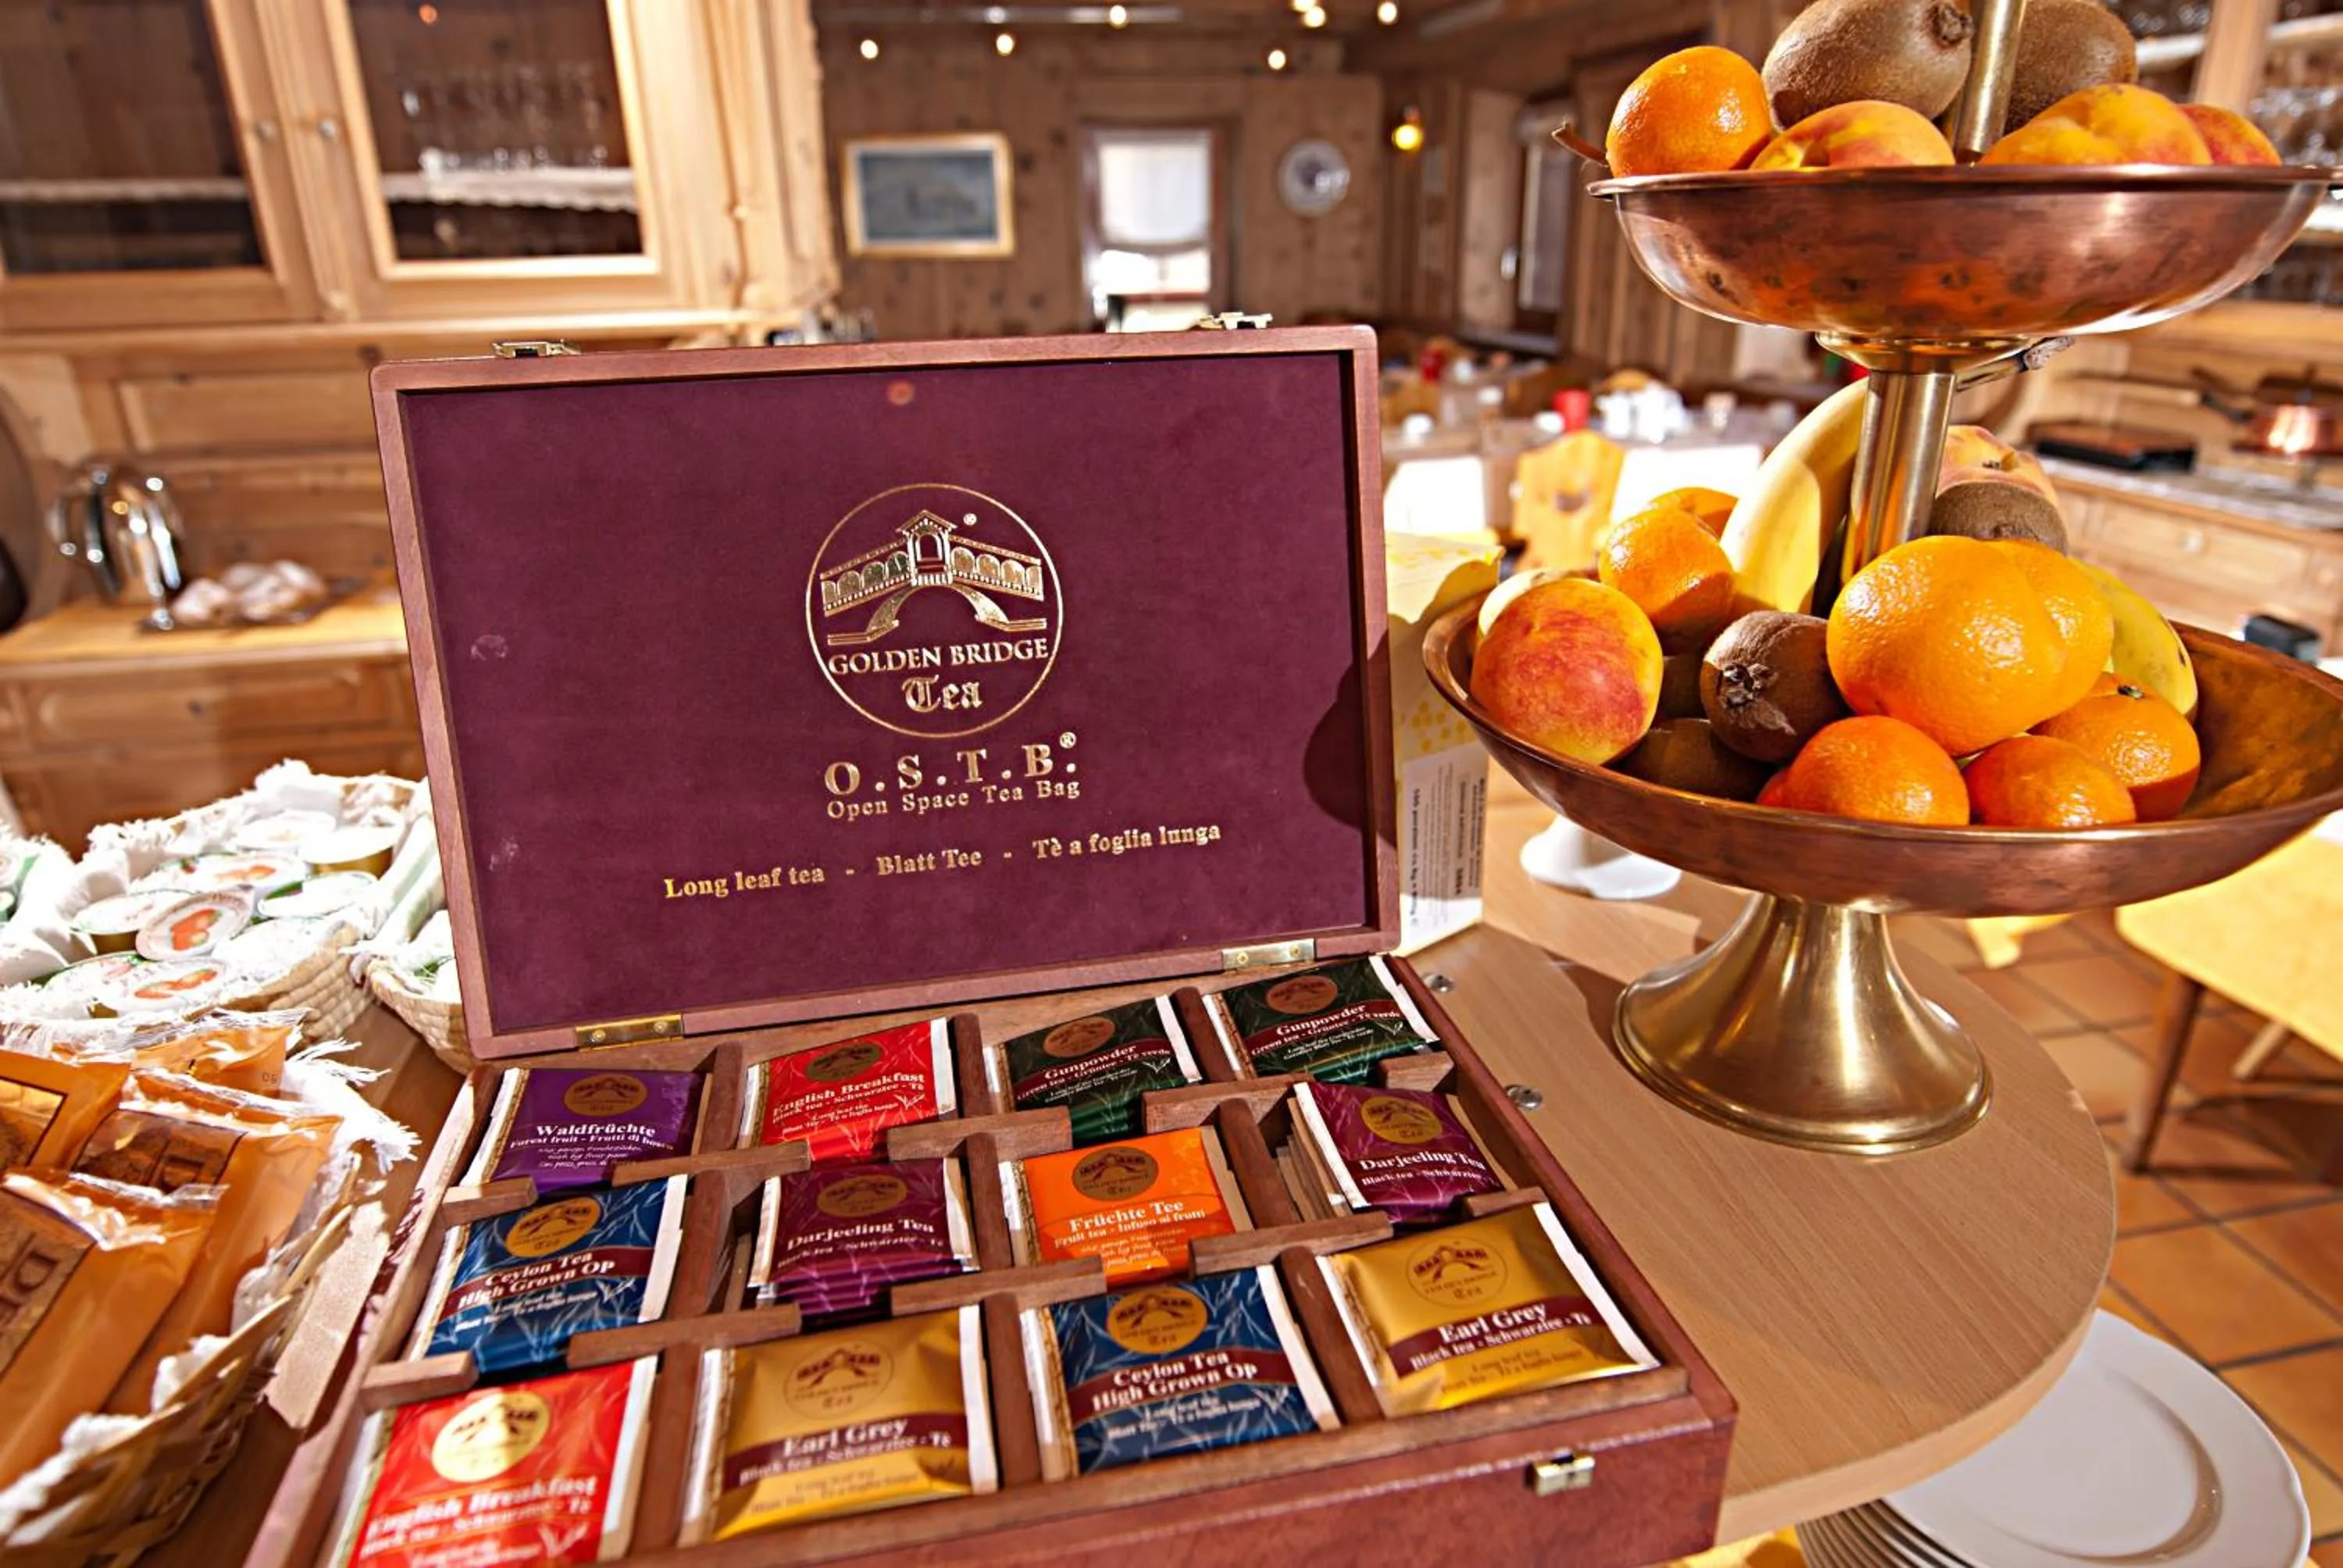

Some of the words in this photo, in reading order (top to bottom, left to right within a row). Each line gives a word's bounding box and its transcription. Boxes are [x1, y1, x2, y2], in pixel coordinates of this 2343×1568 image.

[829, 647, 942, 675] GOLDEN
[949, 637, 1049, 666] BRIDGE
[901, 674, 982, 712] Tea
[827, 800, 888, 821] Open
[902, 792, 969, 814] Space
[982, 784, 1024, 804] Tea
[1036, 780, 1080, 798] Bag
[664, 878, 729, 898] Long
[734, 867, 782, 892] leaf
[788, 867, 826, 886] tea
[876, 852, 937, 876] Blatt
[942, 848, 982, 869] Tee
[1032, 836, 1063, 859] Tè
[1068, 839, 1083, 857] a
[1089, 829, 1154, 855] foglia
[1159, 825, 1222, 846] lunga
[1275, 1004, 1366, 1036] Gunpowder
[1044, 1045, 1137, 1079] Gunpowder
[1251, 1038, 1282, 1056] Green
[1283, 1033, 1300, 1043] tea
[772, 1089, 836, 1117] English
[840, 1071, 925, 1094] Breakfast
[537, 1122, 656, 1139] Waldfrüchte
[551, 1134, 579, 1143] fruit
[1360, 1150, 1457, 1171] Darjeeling
[1454, 1151, 1487, 1171] Tea
[1361, 1171, 1396, 1186] Black
[1069, 1207, 1147, 1233] Früchte
[1149, 1199, 1185, 1215] Tee
[786, 1223, 894, 1251] Darjeeling
[899, 1217, 935, 1234] Tea
[1054, 1232, 1086, 1249] Fruit
[484, 1261, 553, 1285] Ceylon
[558, 1250, 594, 1269] Tea
[458, 1283, 505, 1310] High
[510, 1270, 576, 1295] Grown
[1438, 1316, 1490, 1345] Earl
[1492, 1303, 1547, 1329] Grey
[1113, 1361, 1186, 1387] Ceylon
[1189, 1351, 1230, 1370] Tea
[1410, 1345, 1452, 1373] Black
[1452, 1340, 1476, 1356] tea
[1092, 1386, 1144, 1413] High
[1148, 1370, 1221, 1396] Grown
[783, 1427, 840, 1458] Earl
[845, 1418, 909, 1445] Grey
[471, 1475, 598, 1513] Breakfast
